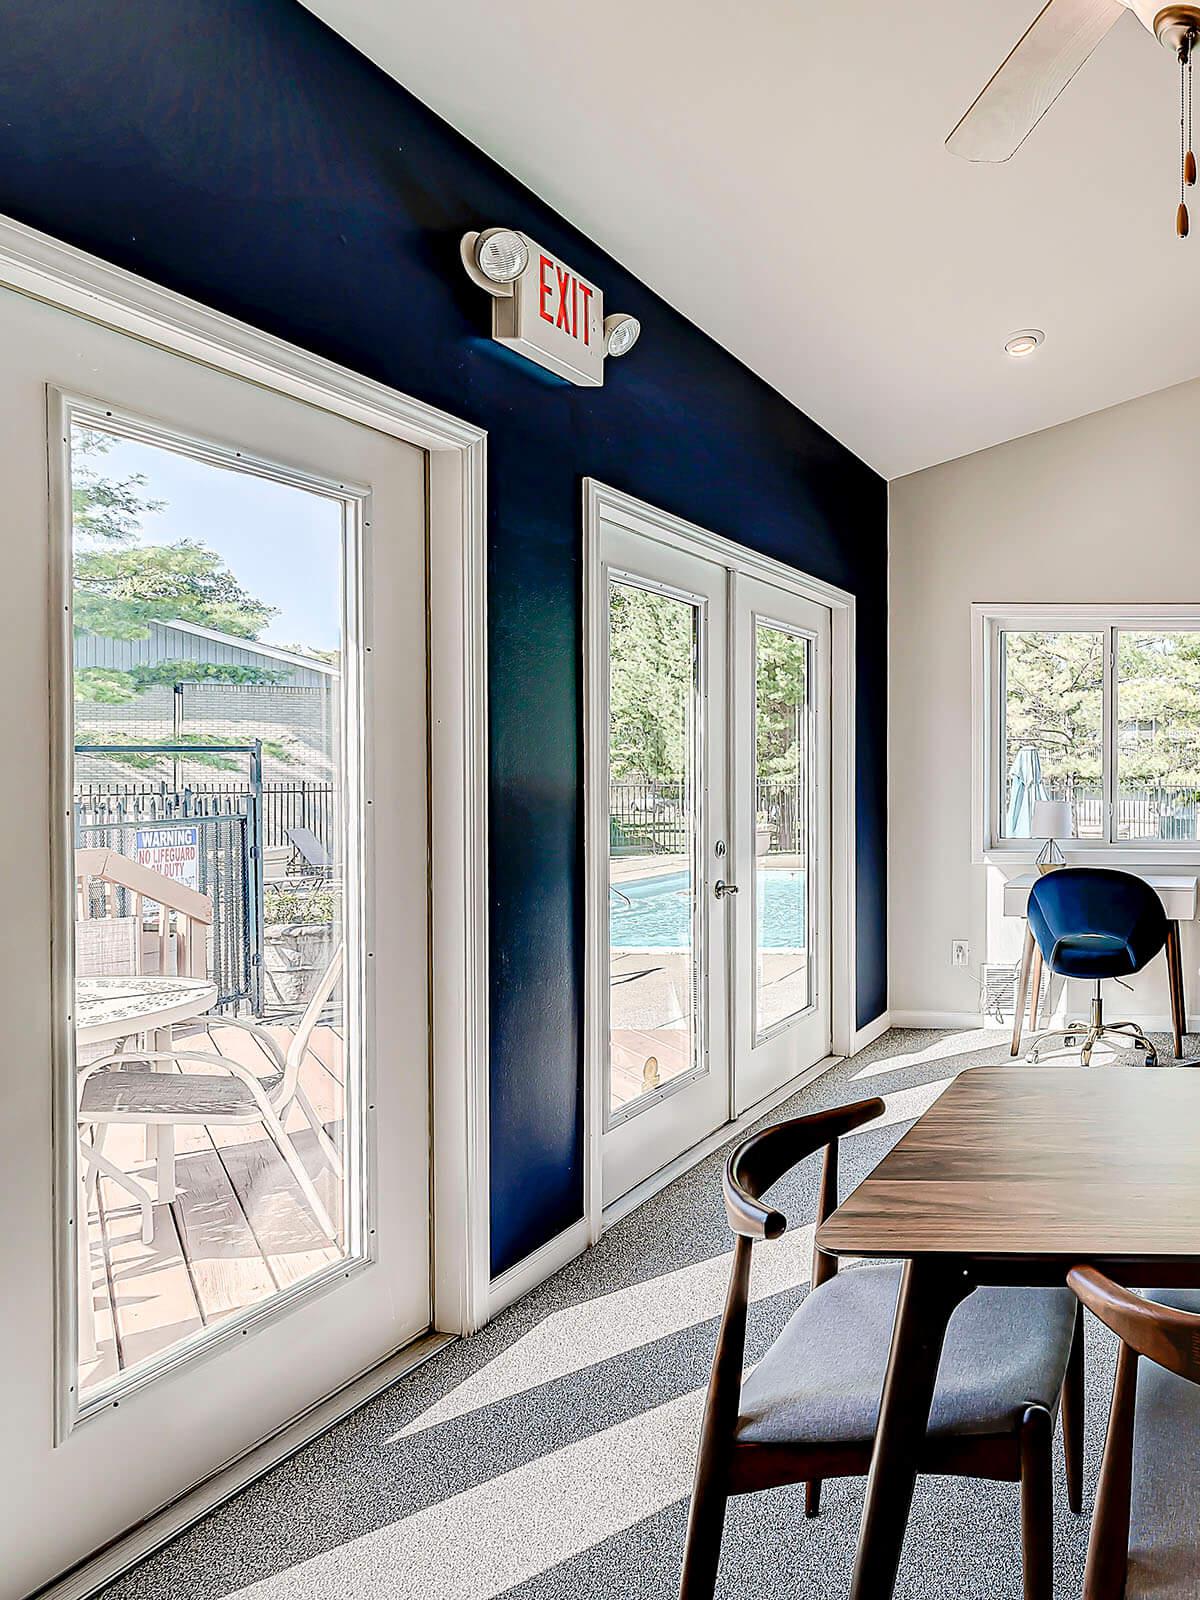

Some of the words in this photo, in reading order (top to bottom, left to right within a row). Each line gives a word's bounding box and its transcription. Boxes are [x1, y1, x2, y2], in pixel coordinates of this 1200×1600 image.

[540, 255, 593, 345] EXIT
[142, 830, 192, 847] WARNING
[139, 850, 150, 864] NO
[153, 847, 195, 863] LIFEGUARD
[164, 863, 184, 877] DUTY
